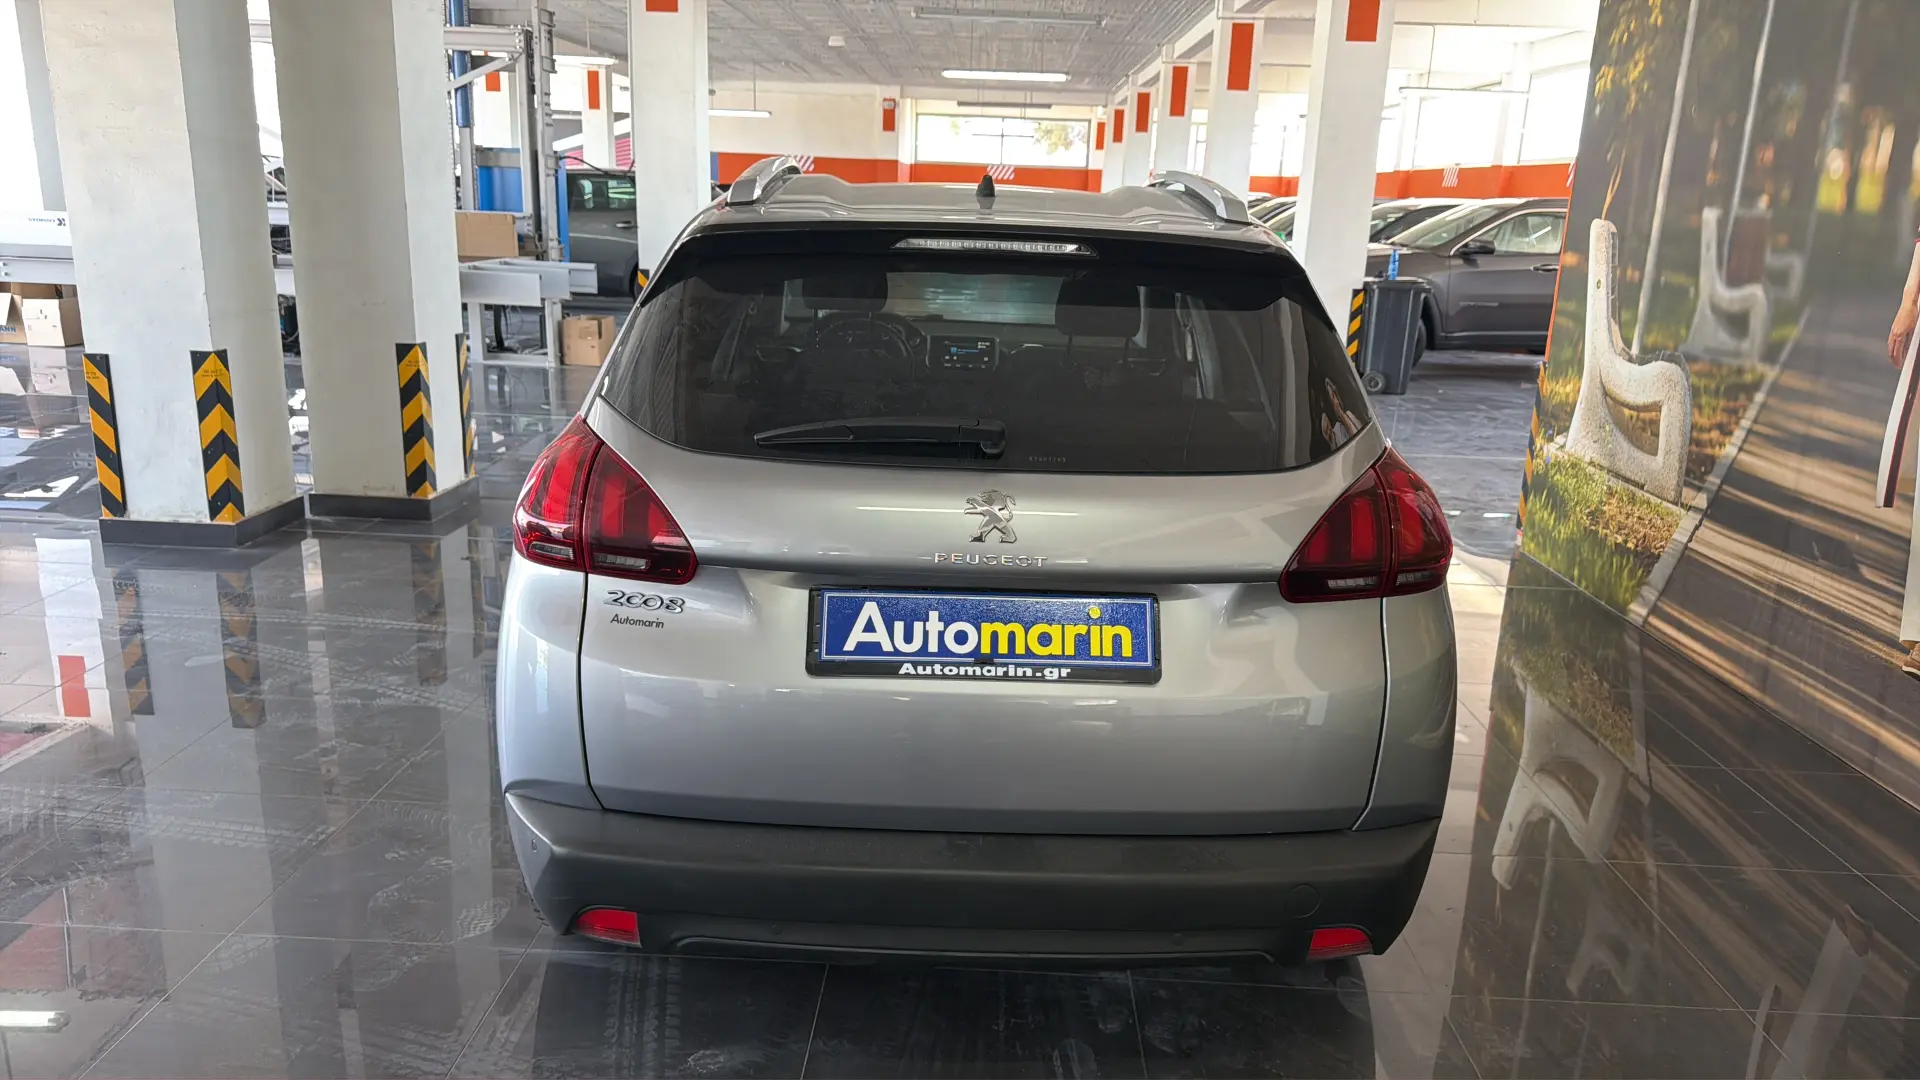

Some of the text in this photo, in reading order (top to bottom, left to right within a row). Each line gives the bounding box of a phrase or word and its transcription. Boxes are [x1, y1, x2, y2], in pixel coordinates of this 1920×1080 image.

[934, 552, 1048, 567] PEUGEOT
[603, 589, 686, 615] 2008
[610, 613, 665, 629] Automarin
[842, 600, 1133, 658] Automarin
[898, 662, 1072, 680] Automarin.gr
